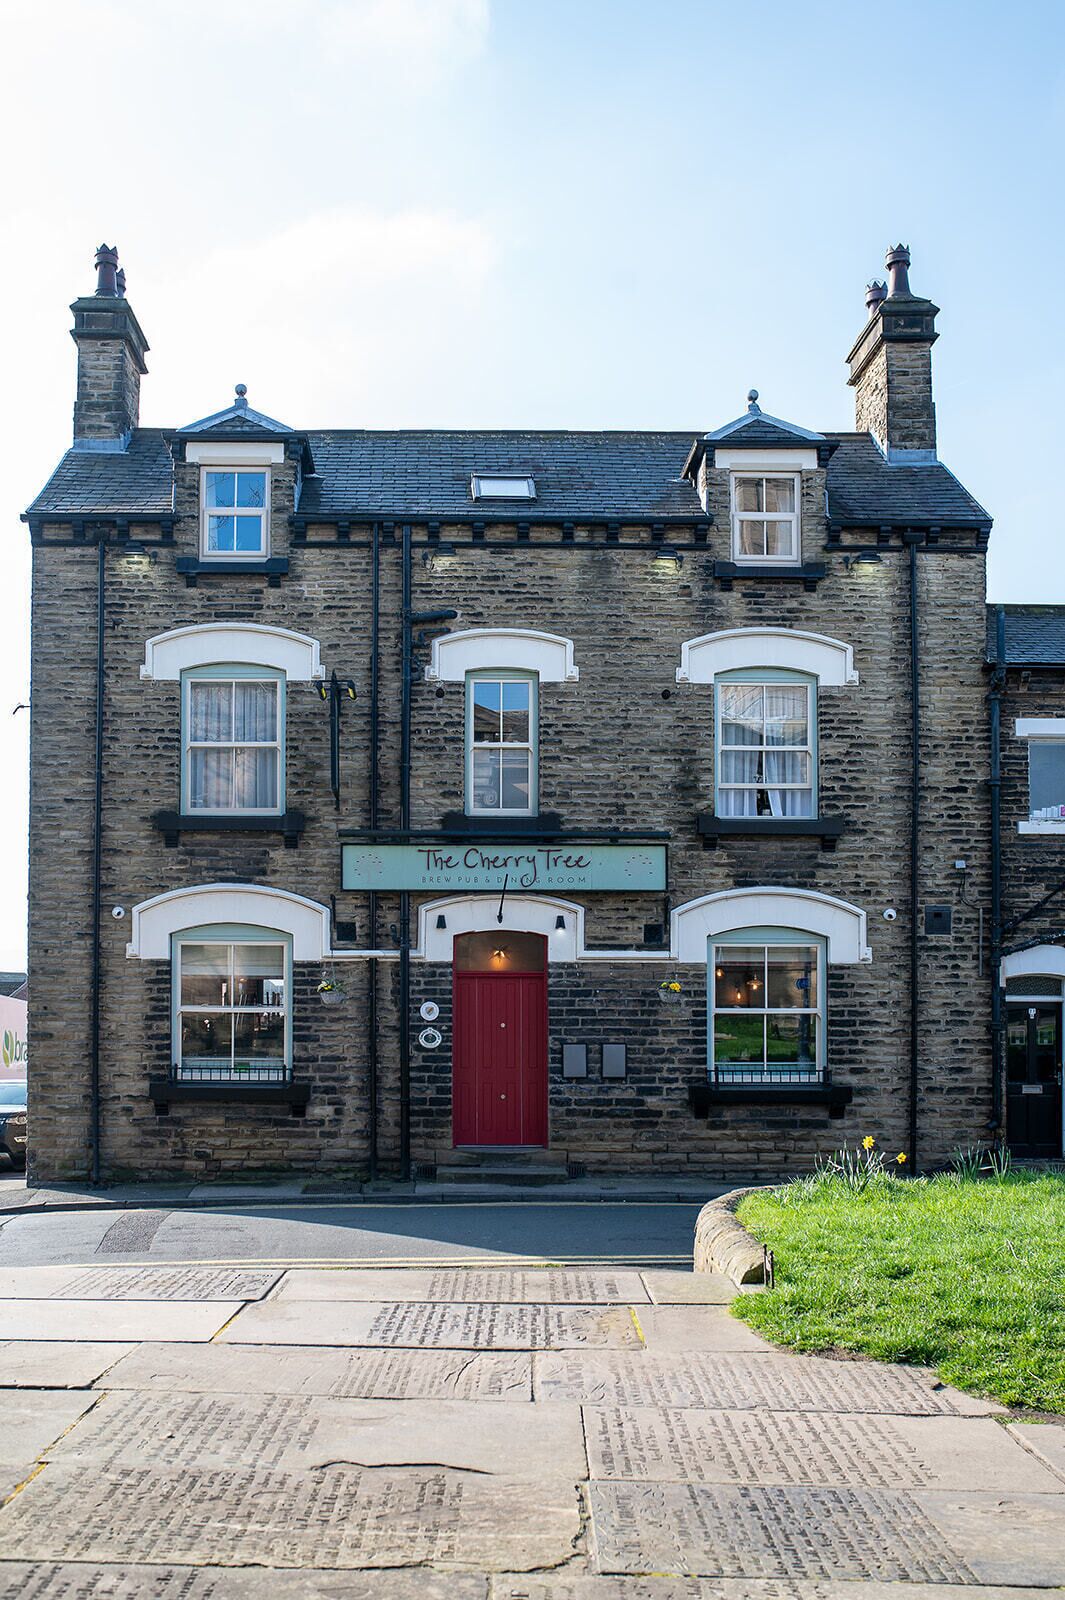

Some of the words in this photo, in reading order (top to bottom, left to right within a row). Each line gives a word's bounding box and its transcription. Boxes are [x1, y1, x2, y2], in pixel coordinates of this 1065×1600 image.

[417, 848, 460, 870] The
[464, 848, 537, 888] Cherry
[537, 849, 592, 871] Tree
[421, 876, 451, 884] BREW
[457, 876, 479, 884] PUB
[484, 876, 490, 884] &
[496, 876, 541, 884] DNNG
[548, 876, 586, 884] ROOM
